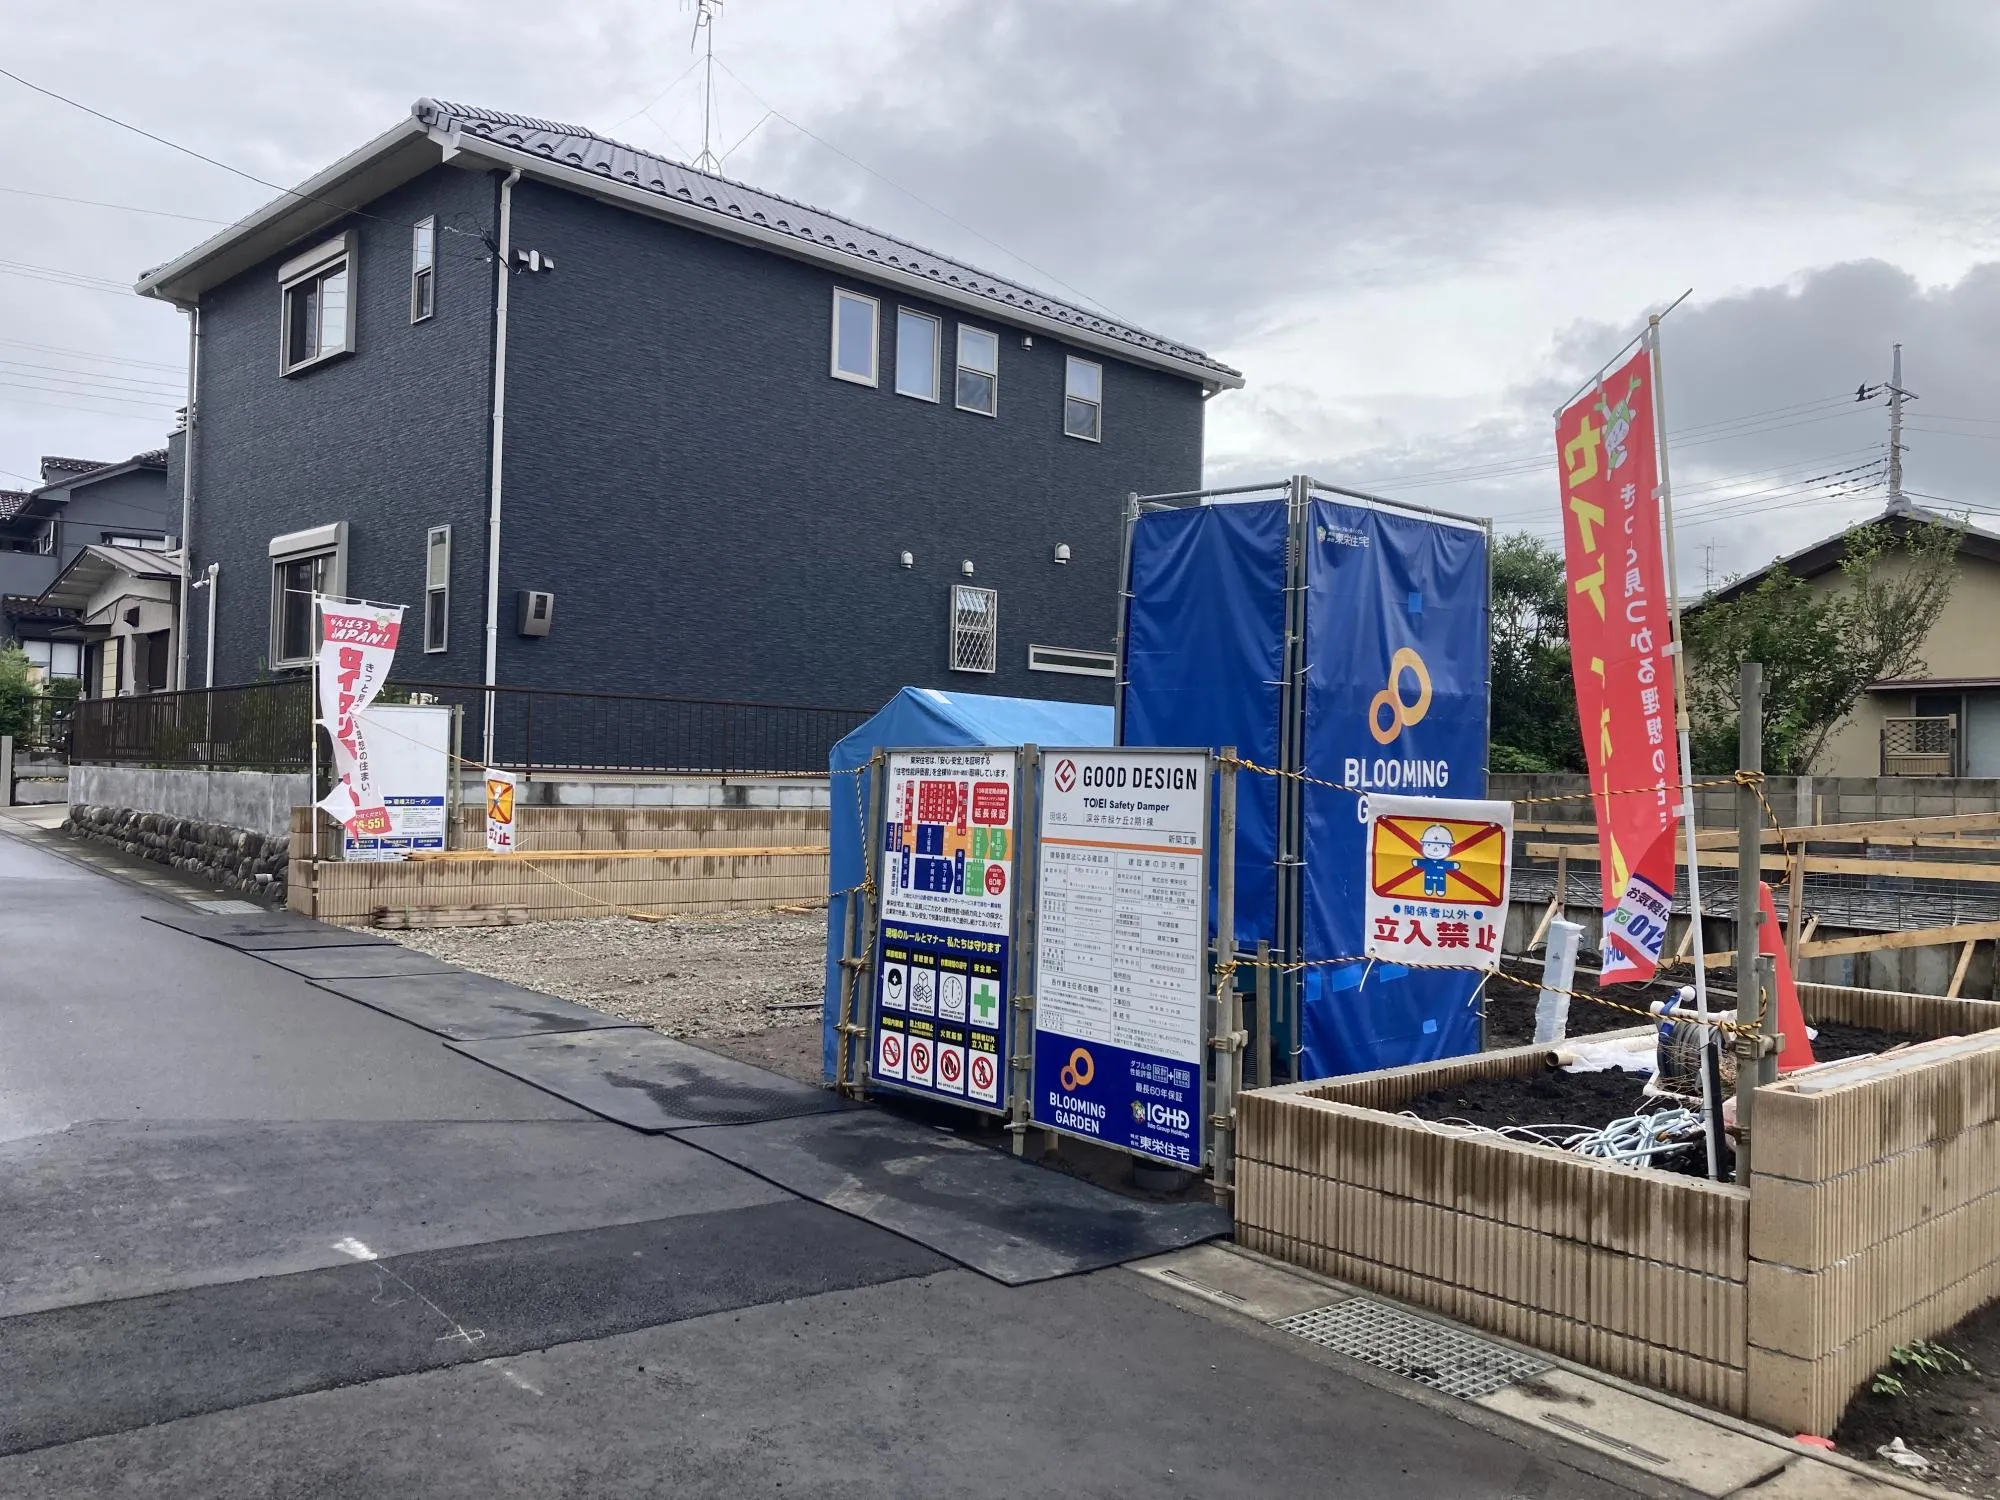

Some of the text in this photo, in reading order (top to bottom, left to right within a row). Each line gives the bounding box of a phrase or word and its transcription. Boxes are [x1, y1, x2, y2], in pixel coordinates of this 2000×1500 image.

[1083, 766, 1197, 790] GOOD DESIGN
[1344, 758, 1449, 788] BLOOMING
[974, 807, 1006, 819] 延長保証
[1109, 800, 1135, 811] Safety
[1137, 801, 1170, 813] Damper
[1168, 834, 1197, 846] 新築工事
[1373, 915, 1498, 953] 立入禁止
[946, 936, 1002, 954] 私たちは守ります
[973, 963, 998, 975] 安全第一
[1130, 1060, 1152, 1071] ダブルの
[1154, 1066, 1167, 1076] 設計
[1135, 1082, 1183, 1103] 最長60年保証
[1049, 1091, 1106, 1119] BLOOMING
[1055, 1109, 1100, 1135] GARDEN
[1156, 1124, 1170, 1134] Group
[1170, 1127, 1190, 1139] Holdings
[1139, 1135, 1191, 1162] 東栄住宅
